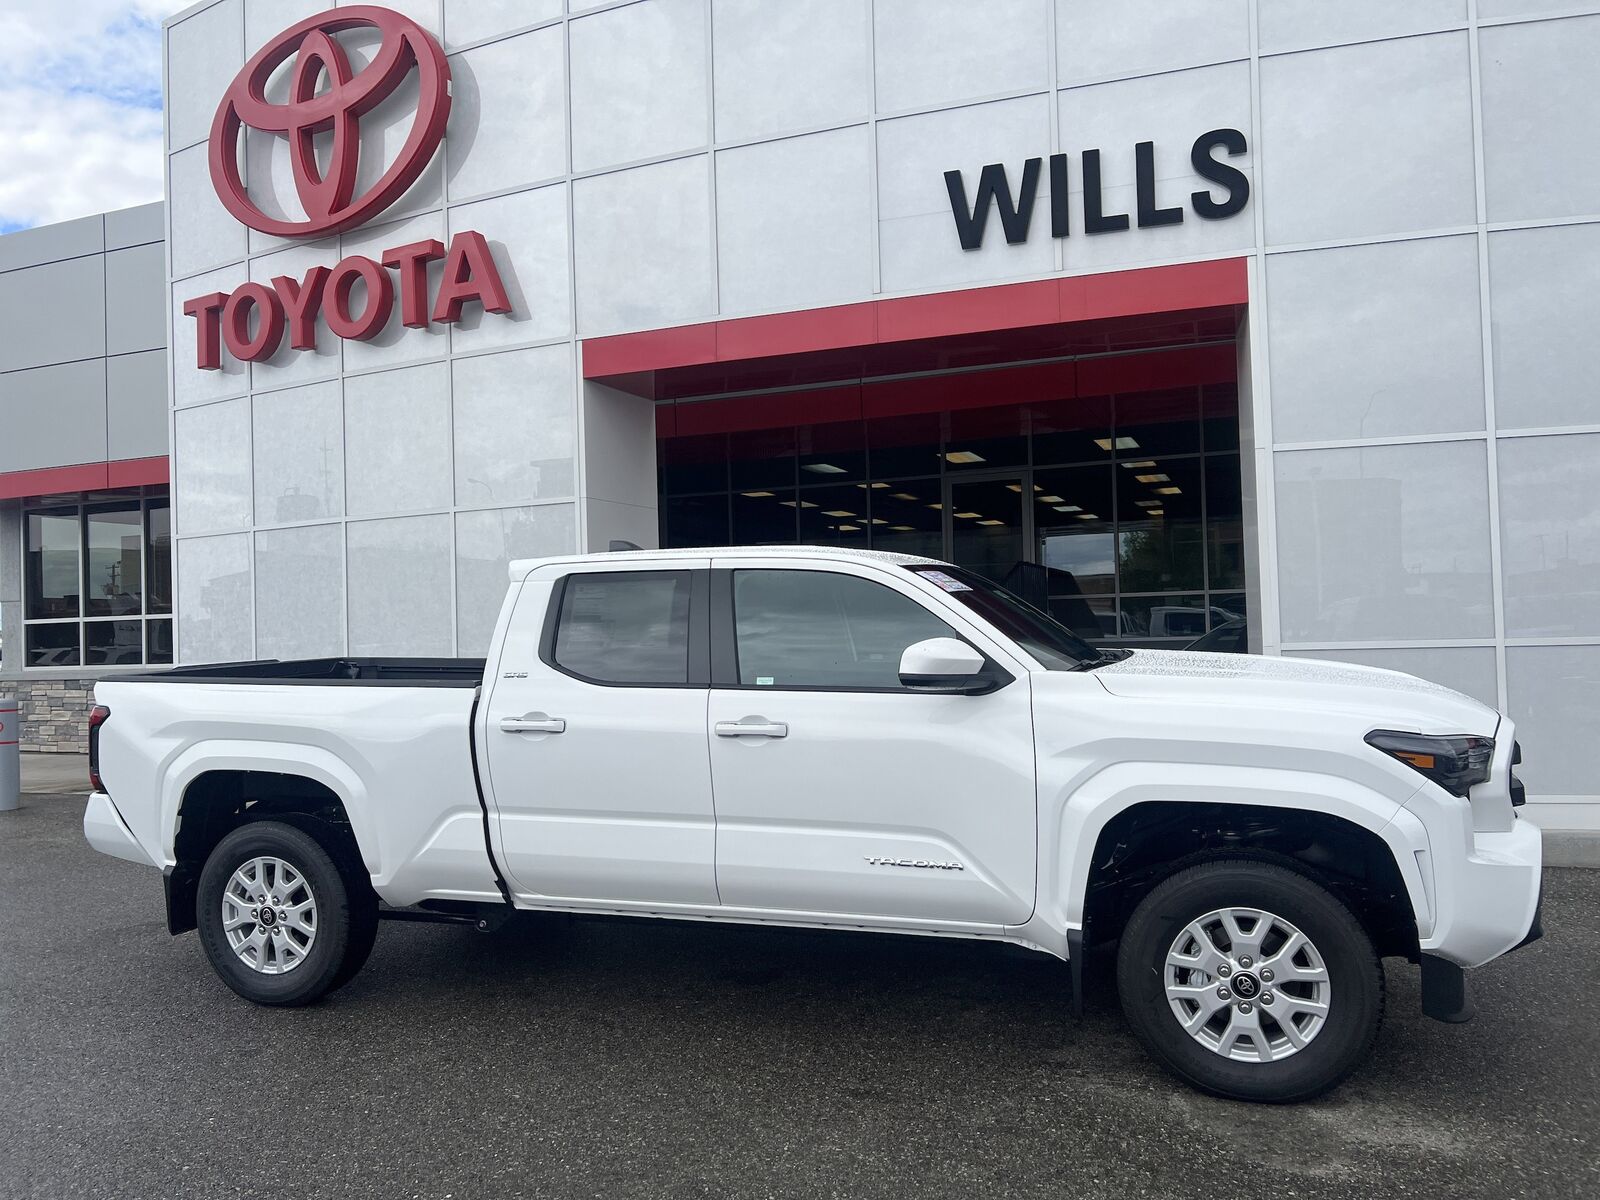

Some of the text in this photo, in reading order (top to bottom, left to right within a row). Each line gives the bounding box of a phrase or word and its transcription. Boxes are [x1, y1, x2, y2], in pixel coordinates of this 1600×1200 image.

[944, 128, 1250, 251] WILLS
[184, 230, 513, 370] TOYOTA
[864, 856, 965, 871] TACOMA
